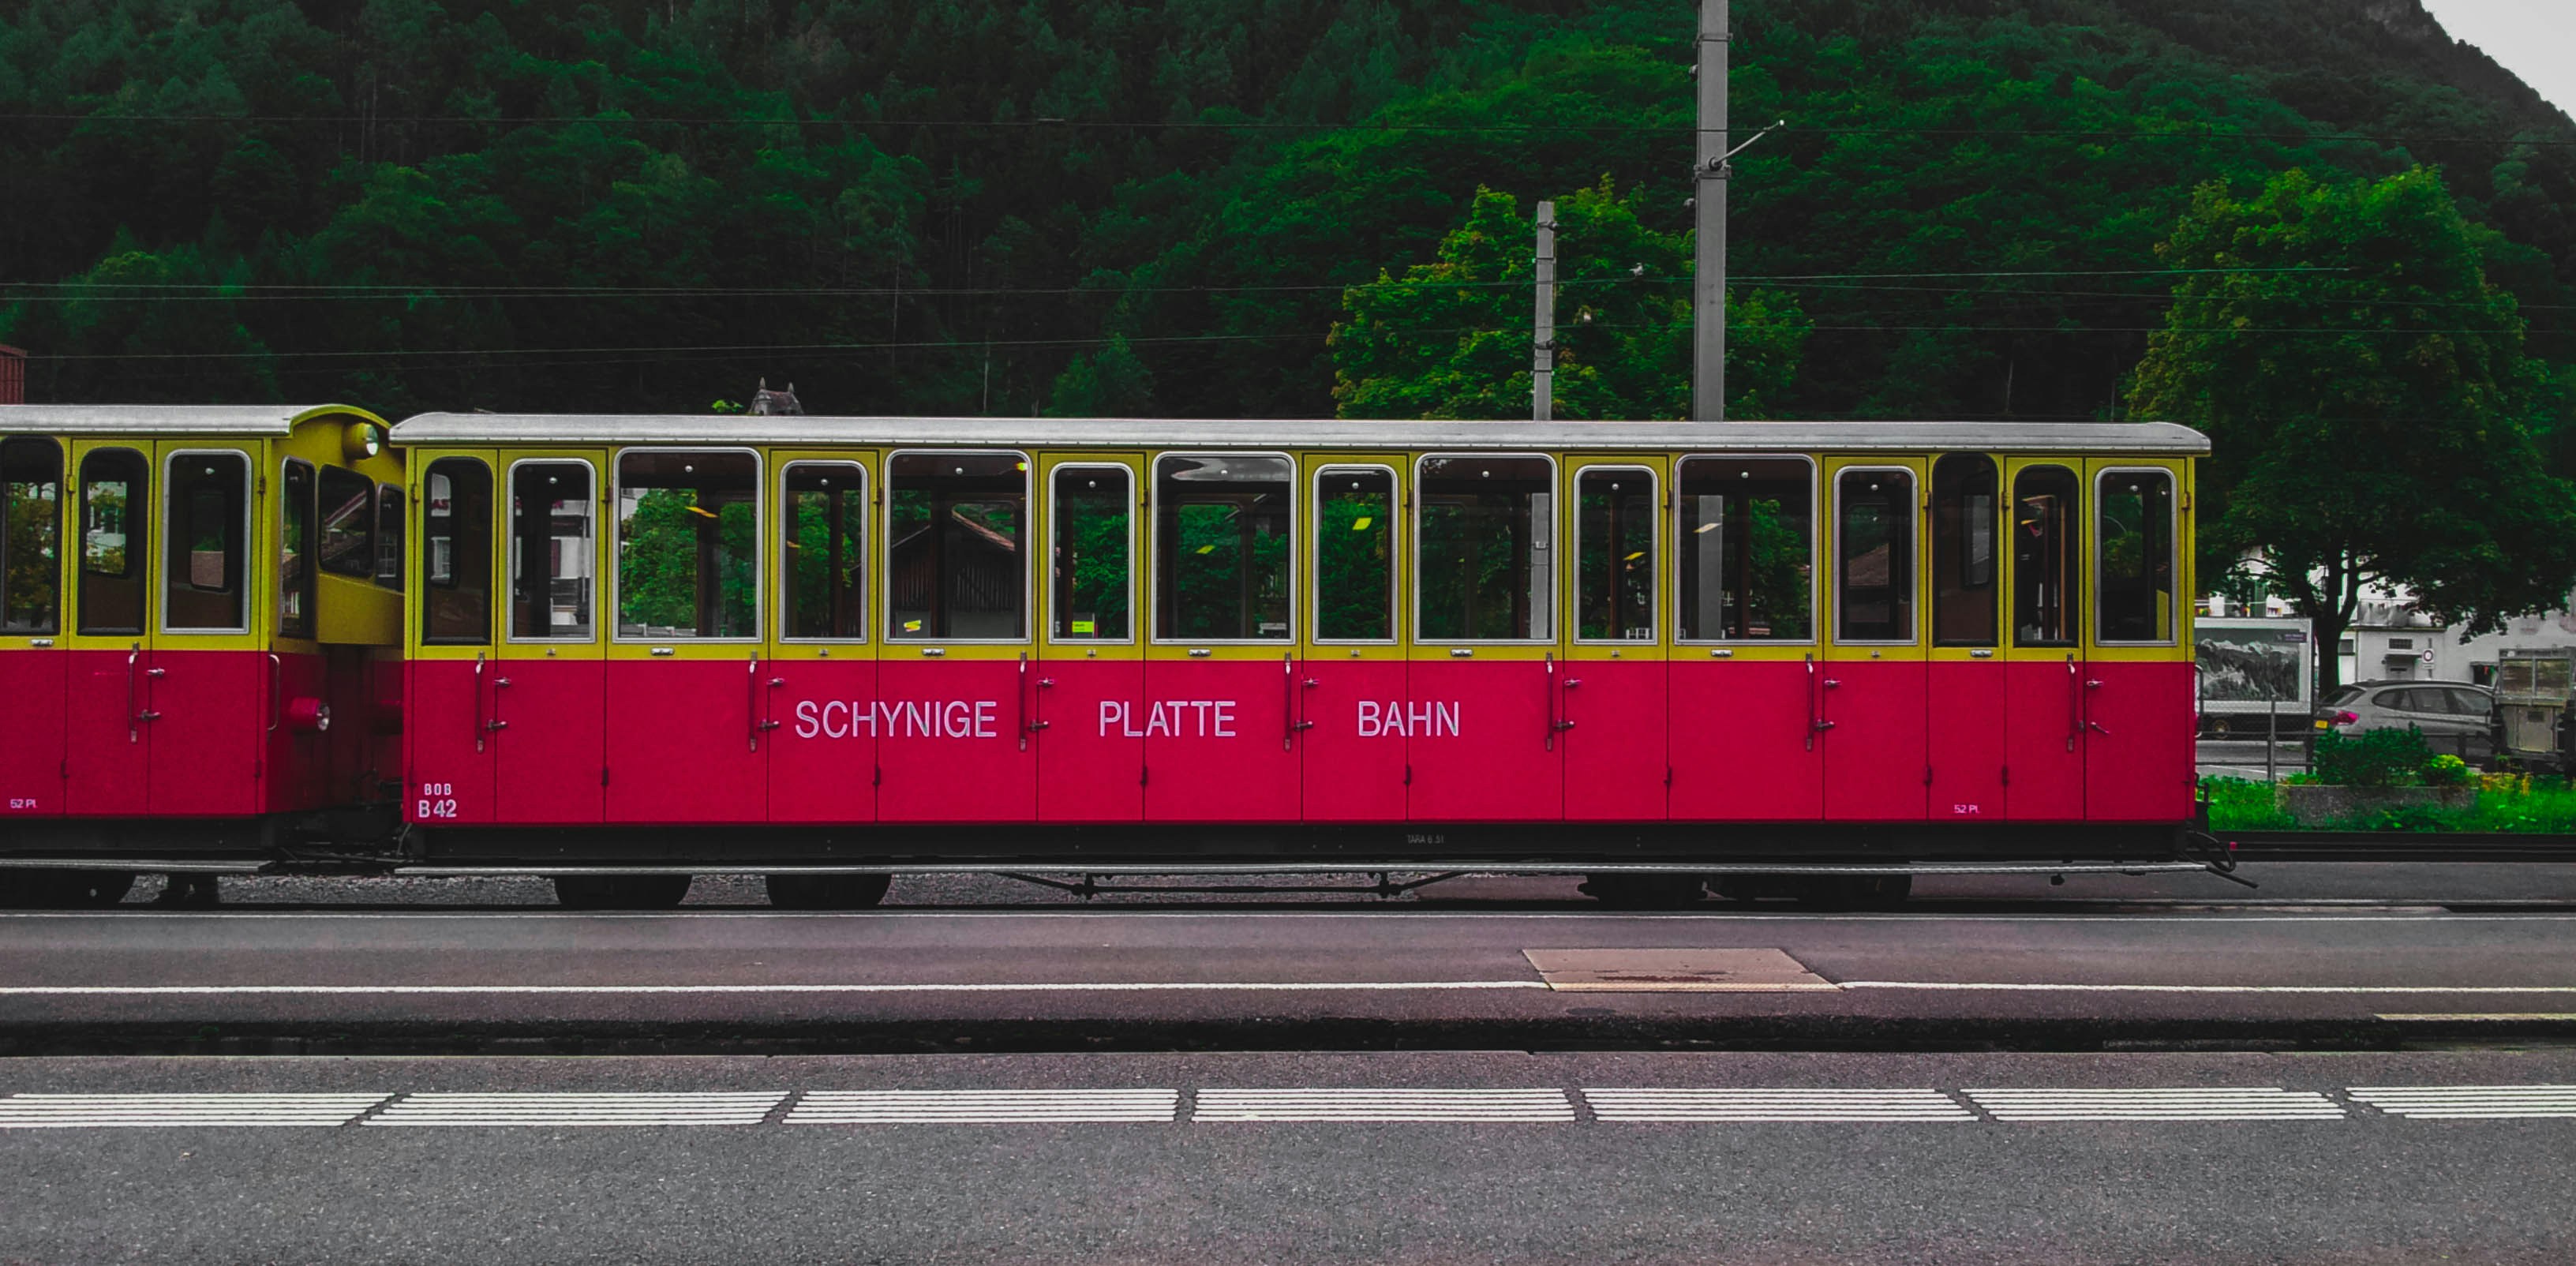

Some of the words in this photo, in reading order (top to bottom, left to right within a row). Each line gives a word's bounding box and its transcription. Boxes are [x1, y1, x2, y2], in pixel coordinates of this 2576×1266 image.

[795, 700, 997, 739] SCHYNIGE
[1099, 700, 1237, 737] PLATTE
[1357, 700, 1459, 737] BAHN
[424, 783, 452, 796] BOB
[9, 799, 24, 809] 52
[418, 800, 430, 818] B
[433, 799, 457, 818] 42
[1953, 804, 1967, 814] 52
